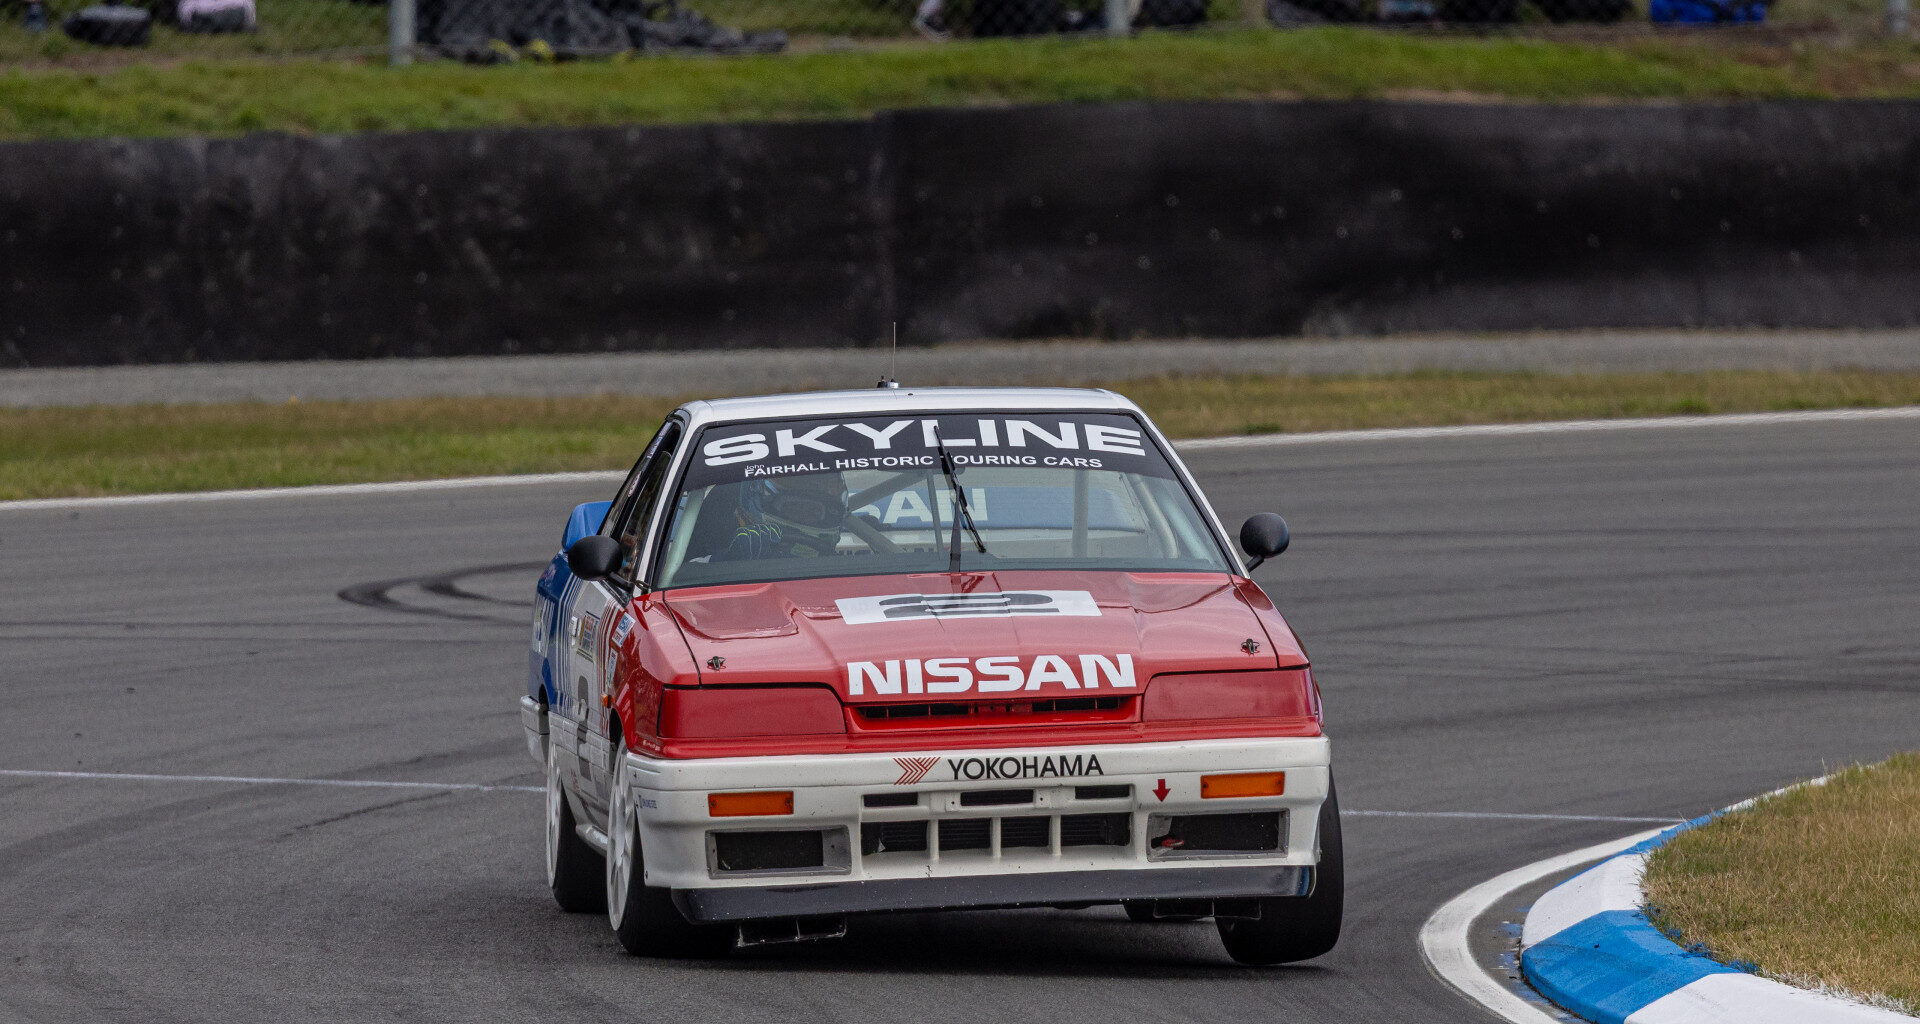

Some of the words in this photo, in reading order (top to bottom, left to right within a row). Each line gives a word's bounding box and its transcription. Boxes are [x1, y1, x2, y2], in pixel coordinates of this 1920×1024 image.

[703, 419, 1146, 467] SKYLINE
[744, 461, 830, 478] FAIRHALL
[835, 455, 934, 468] HISTORIC
[1043, 456, 1103, 468] CARS
[878, 593, 1060, 618] 2
[847, 653, 1137, 696] NISSAN
[948, 754, 1105, 780] YOKOHAMA
